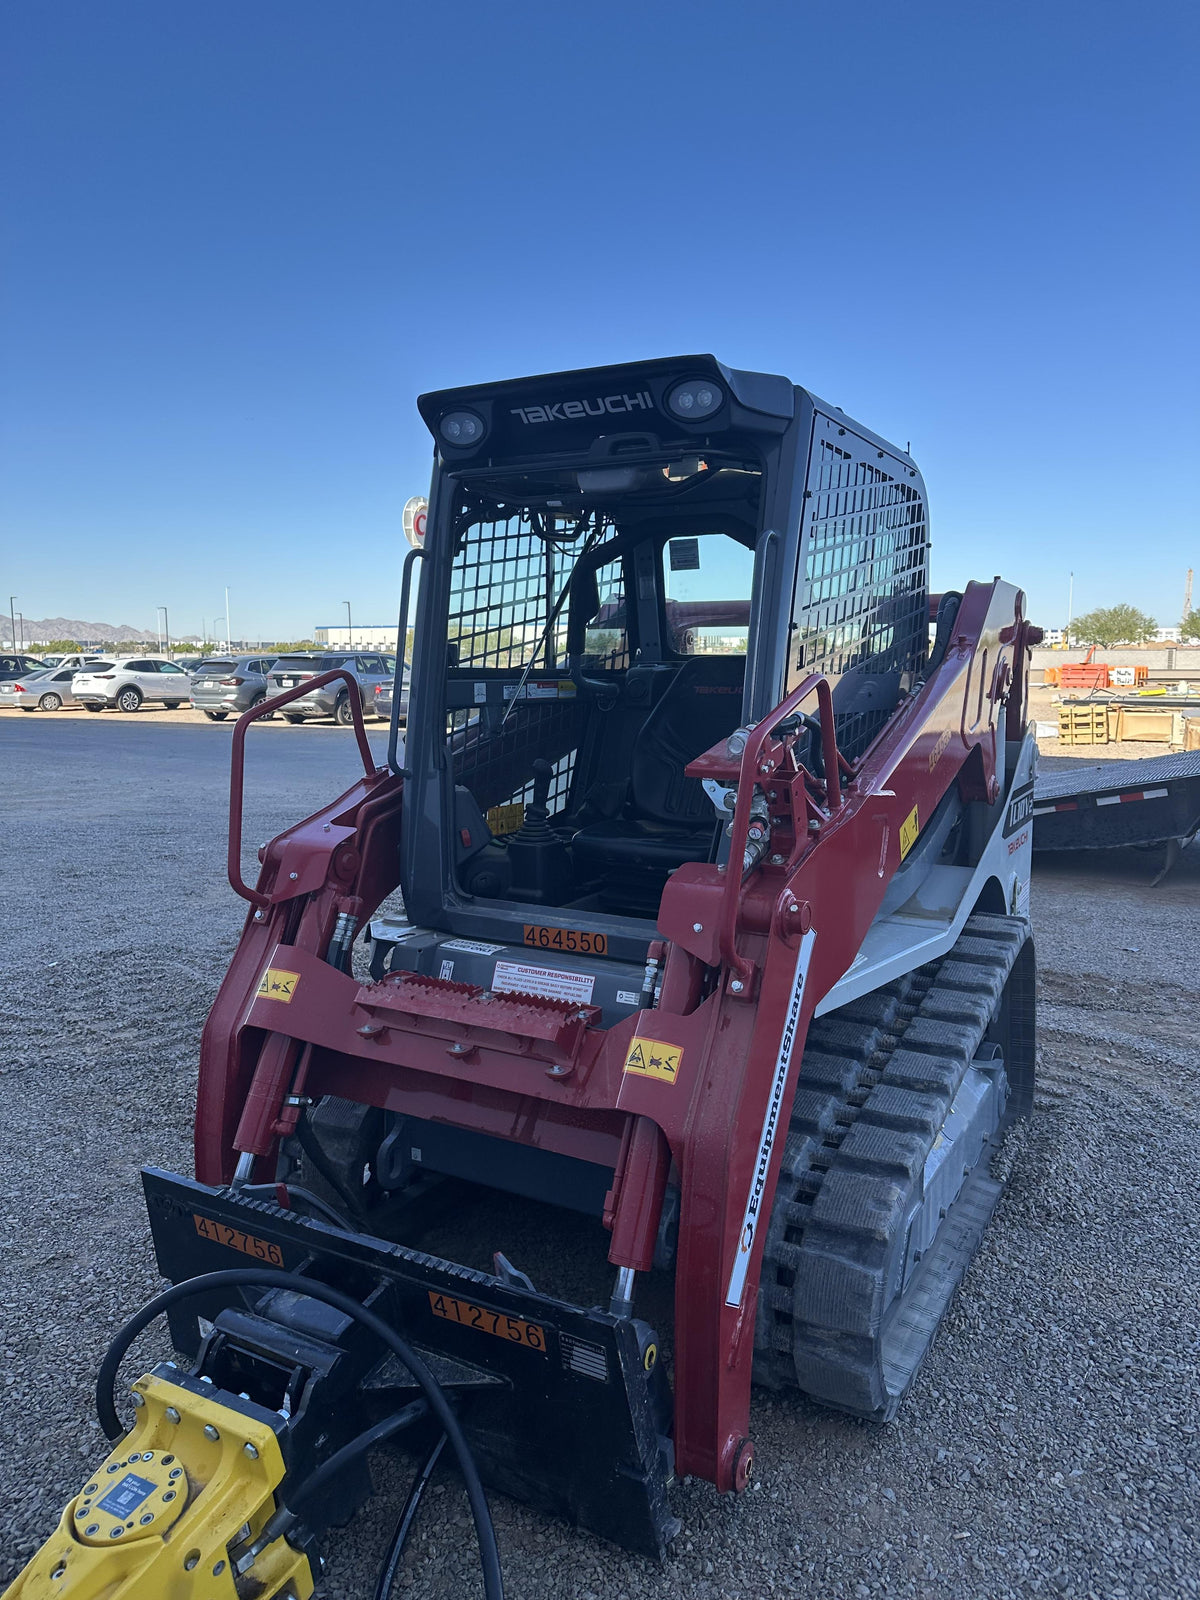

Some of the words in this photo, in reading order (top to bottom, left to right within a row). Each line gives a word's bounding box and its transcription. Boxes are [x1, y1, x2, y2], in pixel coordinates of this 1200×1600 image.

[510, 391, 654, 424] TAKEUCHI
[526, 927, 605, 953] 464550
[517, 966, 546, 976] CUSTOMER
[546, 971, 593, 984] RESPONSIBILITY
[748, 973, 804, 1217] EquipmentShare
[198, 1218, 281, 1265] 412756
[433, 1295, 541, 1348] 412756
